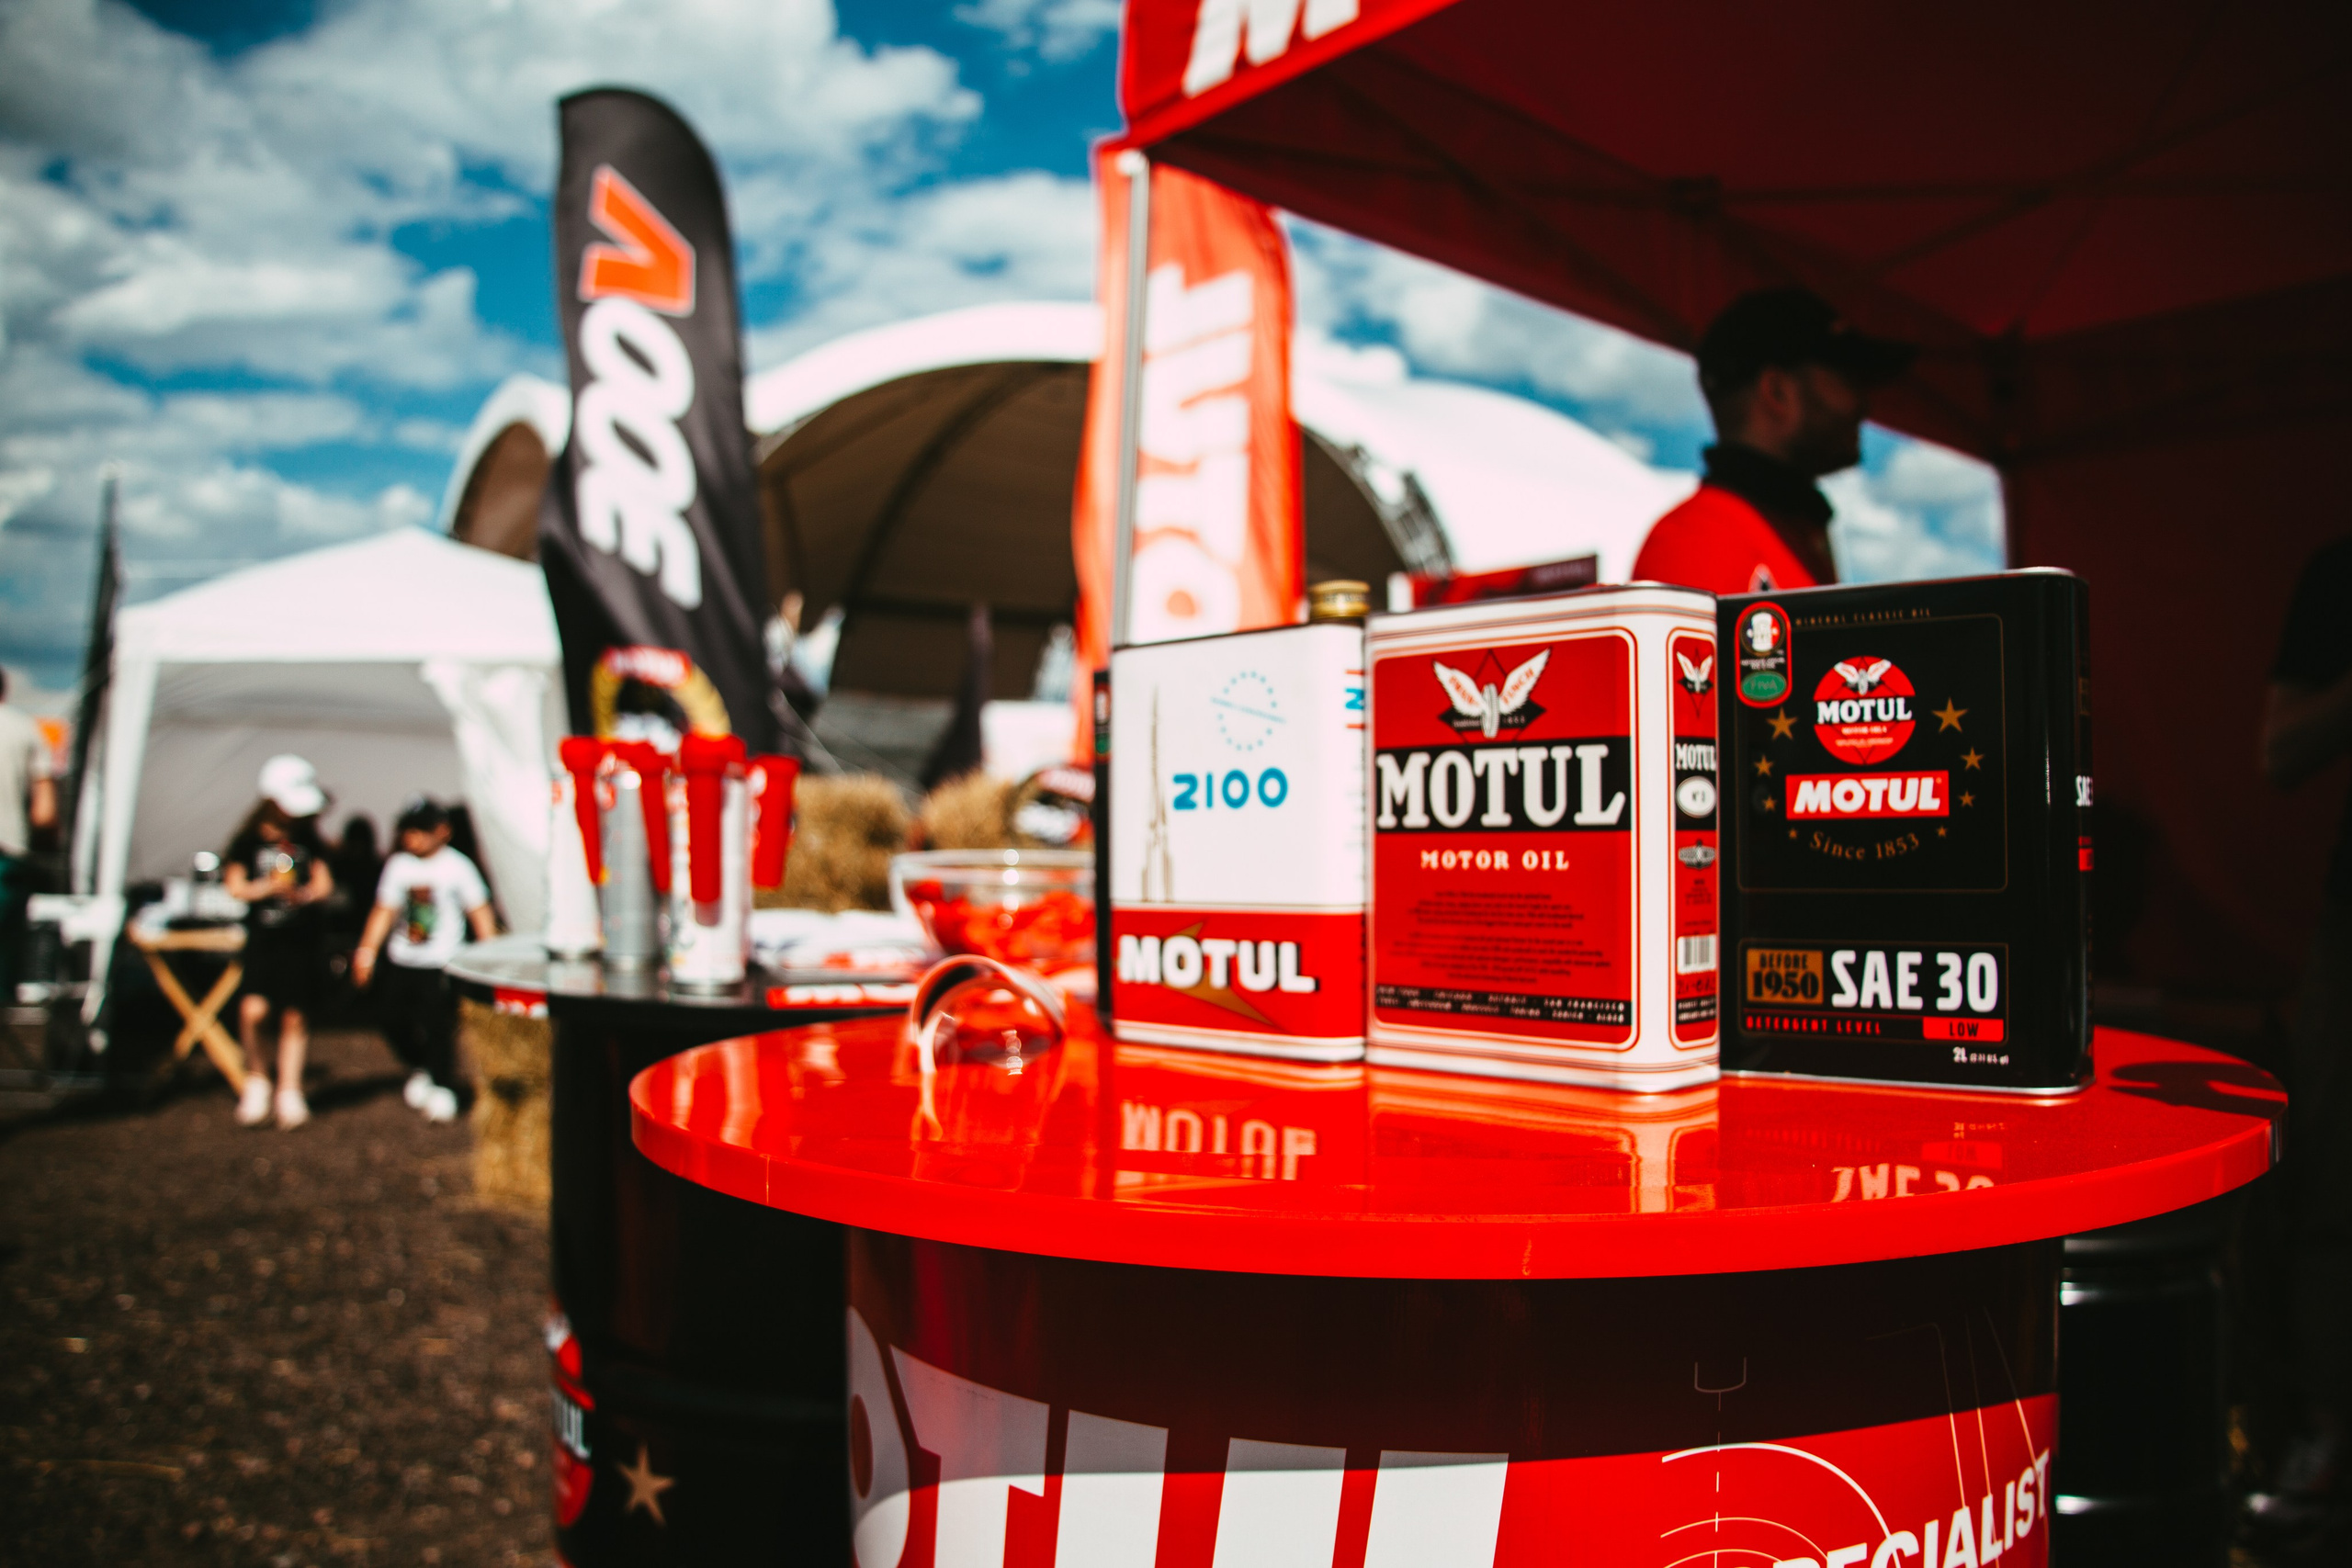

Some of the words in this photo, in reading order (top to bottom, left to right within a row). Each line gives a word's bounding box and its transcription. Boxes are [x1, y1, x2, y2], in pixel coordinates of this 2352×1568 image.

[1816, 697, 1912, 724] MOTUL
[1675, 743, 1716, 771] MOTUL
[1172, 767, 1288, 810] 2100
[1376, 744, 1626, 829] MOTUL
[1792, 776, 1941, 814] MOTUL
[1809, 830, 1865, 860] Since
[1875, 831, 1920, 860] 1853
[1420, 850, 1510, 871] MOTOR
[1521, 850, 1570, 871] OIL
[1118, 933, 1317, 994] MOTUL
[1759, 953, 1808, 969] BEFORE
[1753, 971, 1819, 999] 1950
[1831, 950, 1923, 1010] SAE
[1936, 952, 1998, 1012] 30
[1747, 1015, 1827, 1034] DETERGENT
[1837, 1018, 1882, 1035] LEVEL
[1949, 1021, 1979, 1037] LOW
